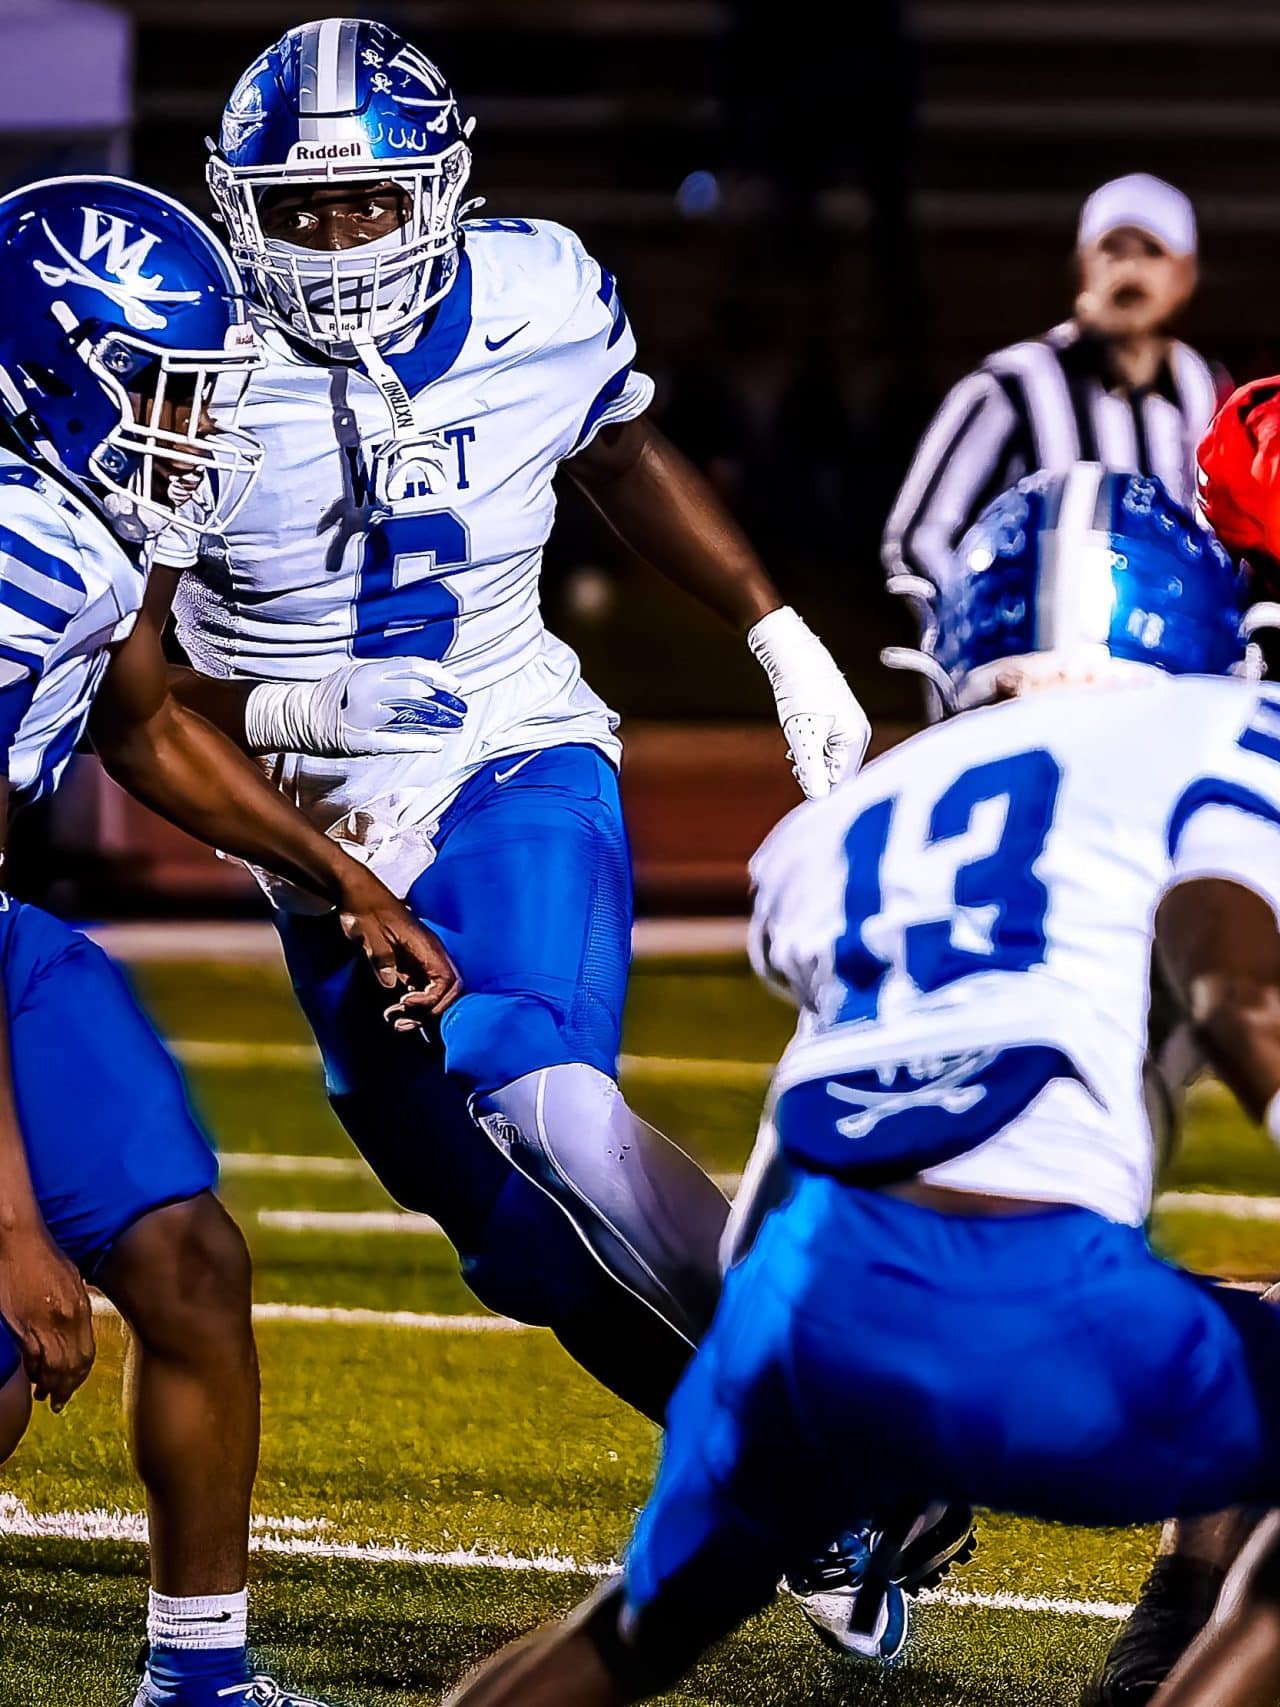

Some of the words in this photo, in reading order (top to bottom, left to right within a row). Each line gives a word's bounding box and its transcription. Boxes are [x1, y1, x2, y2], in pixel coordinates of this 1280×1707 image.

[297, 142, 361, 160] Riddell
[381, 380, 415, 429] NXTRND
[343, 426, 476, 508] WT
[348, 507, 472, 663] 6
[834, 747, 1062, 1026] 13
